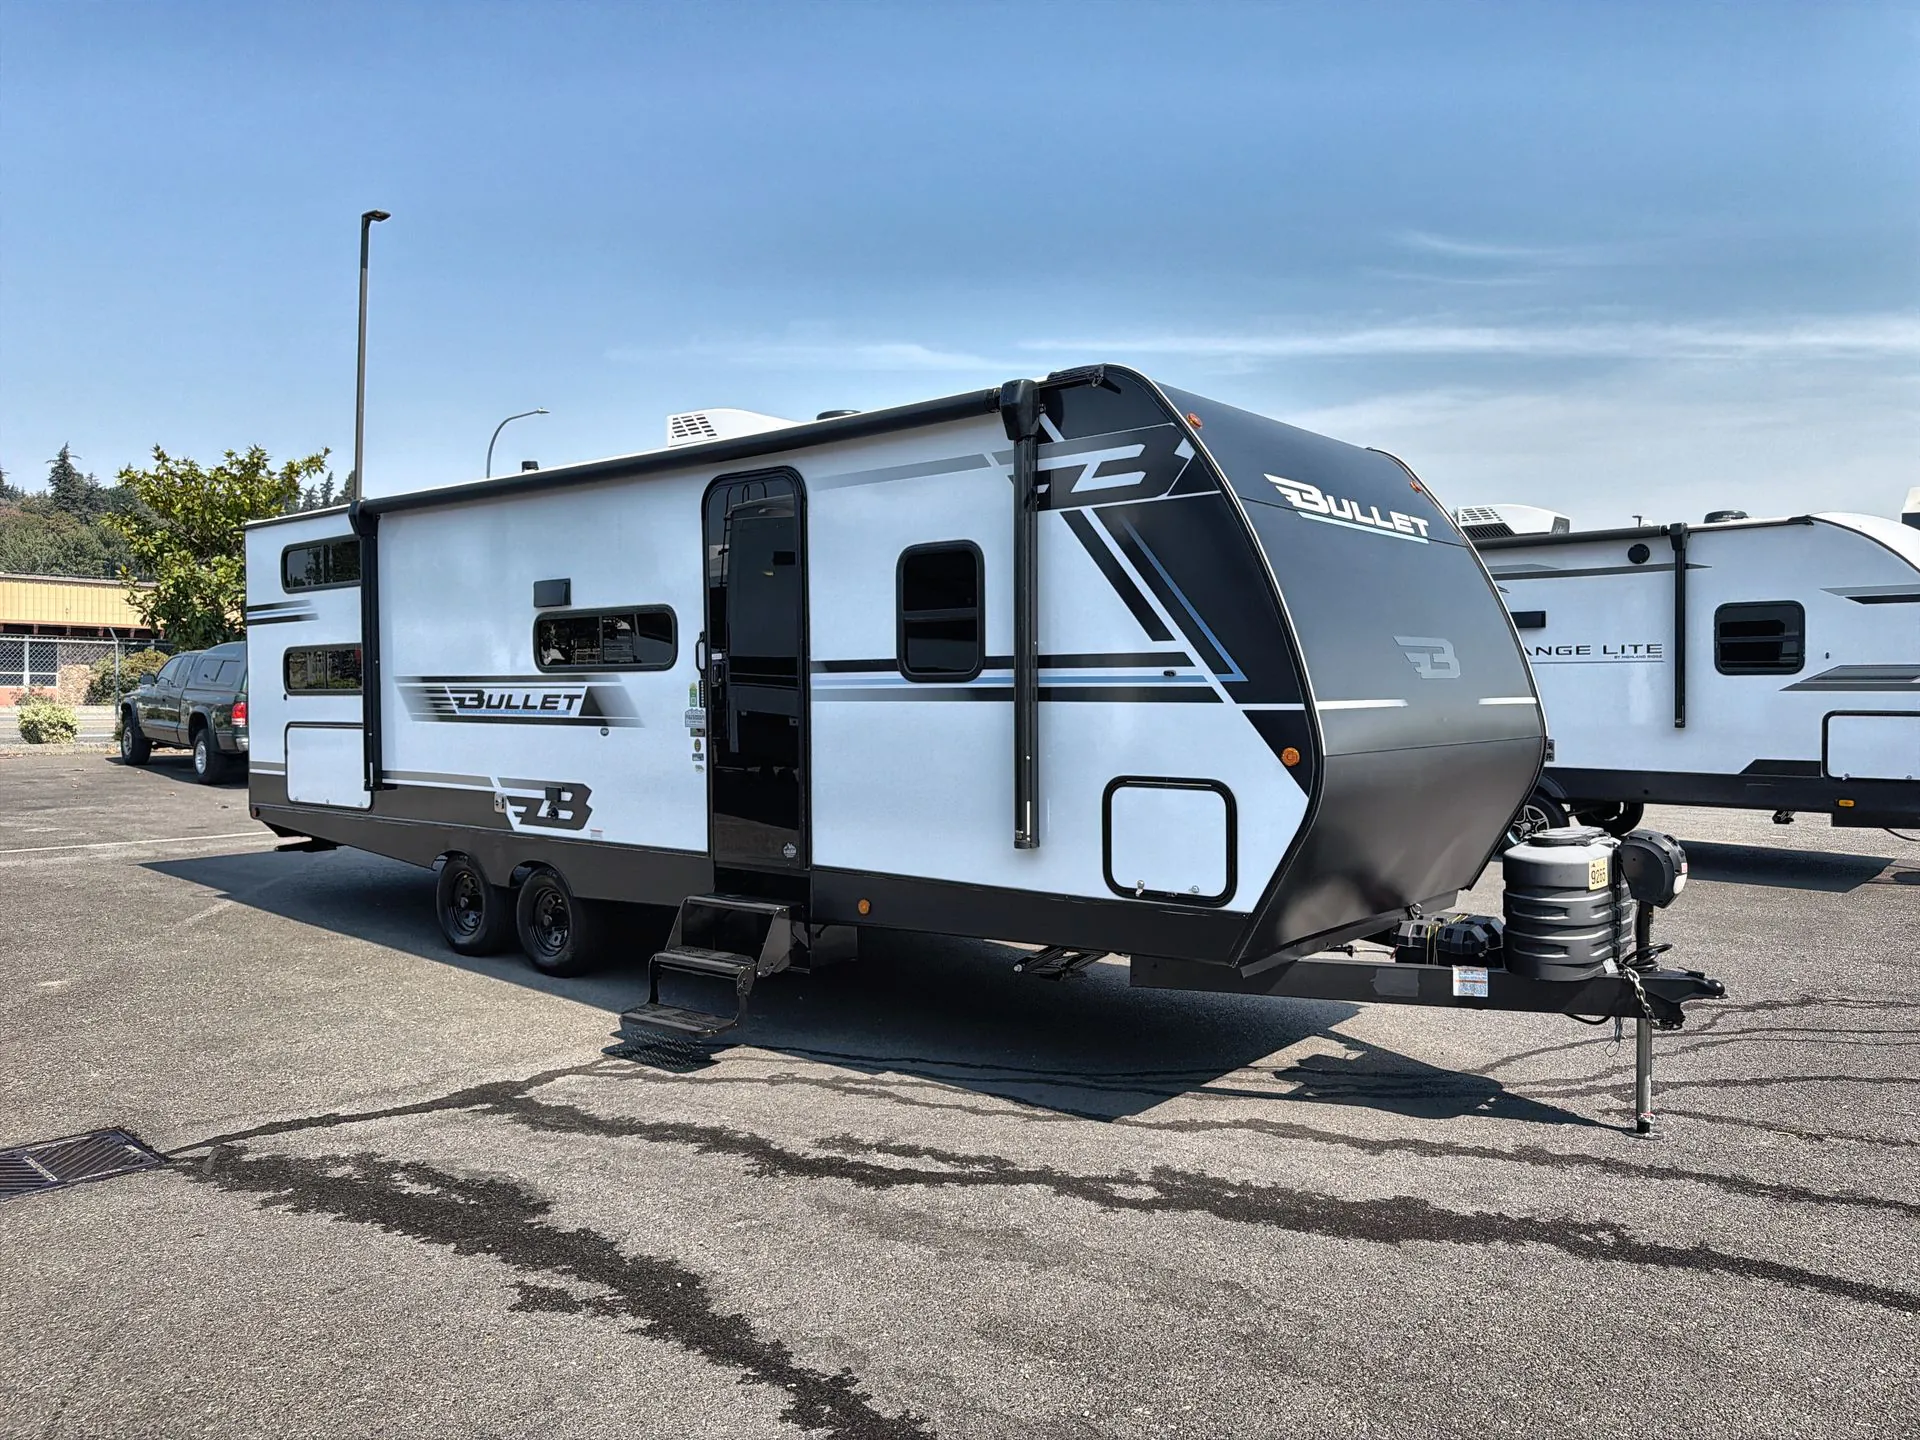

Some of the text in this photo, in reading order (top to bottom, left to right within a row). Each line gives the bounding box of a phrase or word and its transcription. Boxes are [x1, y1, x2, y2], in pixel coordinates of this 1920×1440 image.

[1263, 473, 1429, 537] BULLET
[1603, 643, 1663, 655] LITE
[454, 689, 583, 711] BULLET
